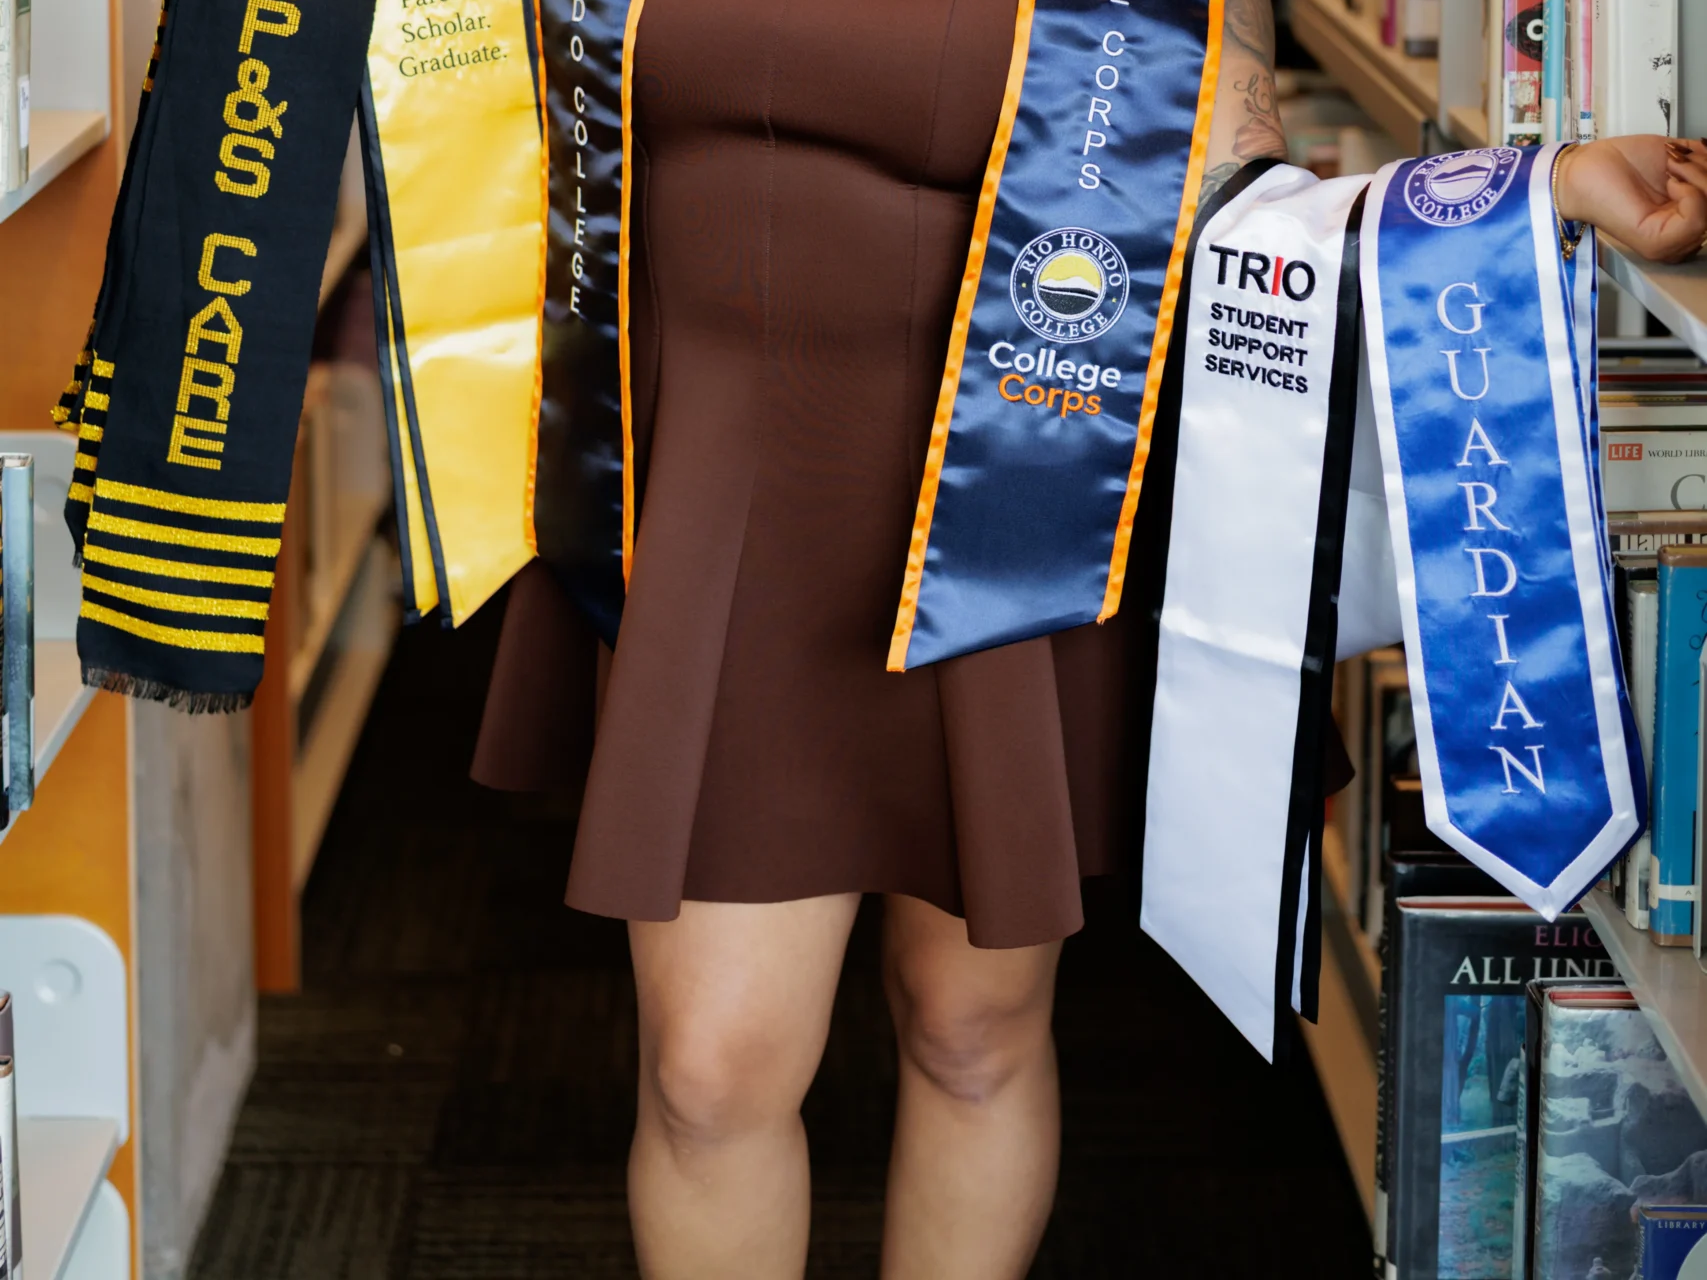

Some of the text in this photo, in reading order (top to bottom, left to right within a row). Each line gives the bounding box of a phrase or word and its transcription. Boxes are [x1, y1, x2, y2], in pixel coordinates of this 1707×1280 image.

[401, 12, 492, 43] Scholar.
[398, 45, 508, 78] Graduate.
[1077, 29, 1126, 191] CORPS
[569, 85, 590, 316] COLLEGE
[1413, 187, 1498, 222] COLLEGE
[1061, 232, 1123, 287] HONDO
[1208, 243, 1317, 302] TRIO
[1021, 299, 1108, 338] COLLEGE
[1210, 301, 1309, 339] STUDENT
[166, 232, 258, 471] CARE
[988, 341, 1122, 392] College
[1207, 328, 1309, 367] SUPPORT
[1204, 353, 1309, 395] SERVICES
[997, 373, 1102, 418] Corps
[1610, 446, 1640, 459] LIFE
[1648, 449, 1683, 458] WORLD
[1436, 281, 1547, 796] GUARDIAN
[1450, 955, 1522, 985] ALL
[1657, 1220, 1706, 1230] LIBRARY
